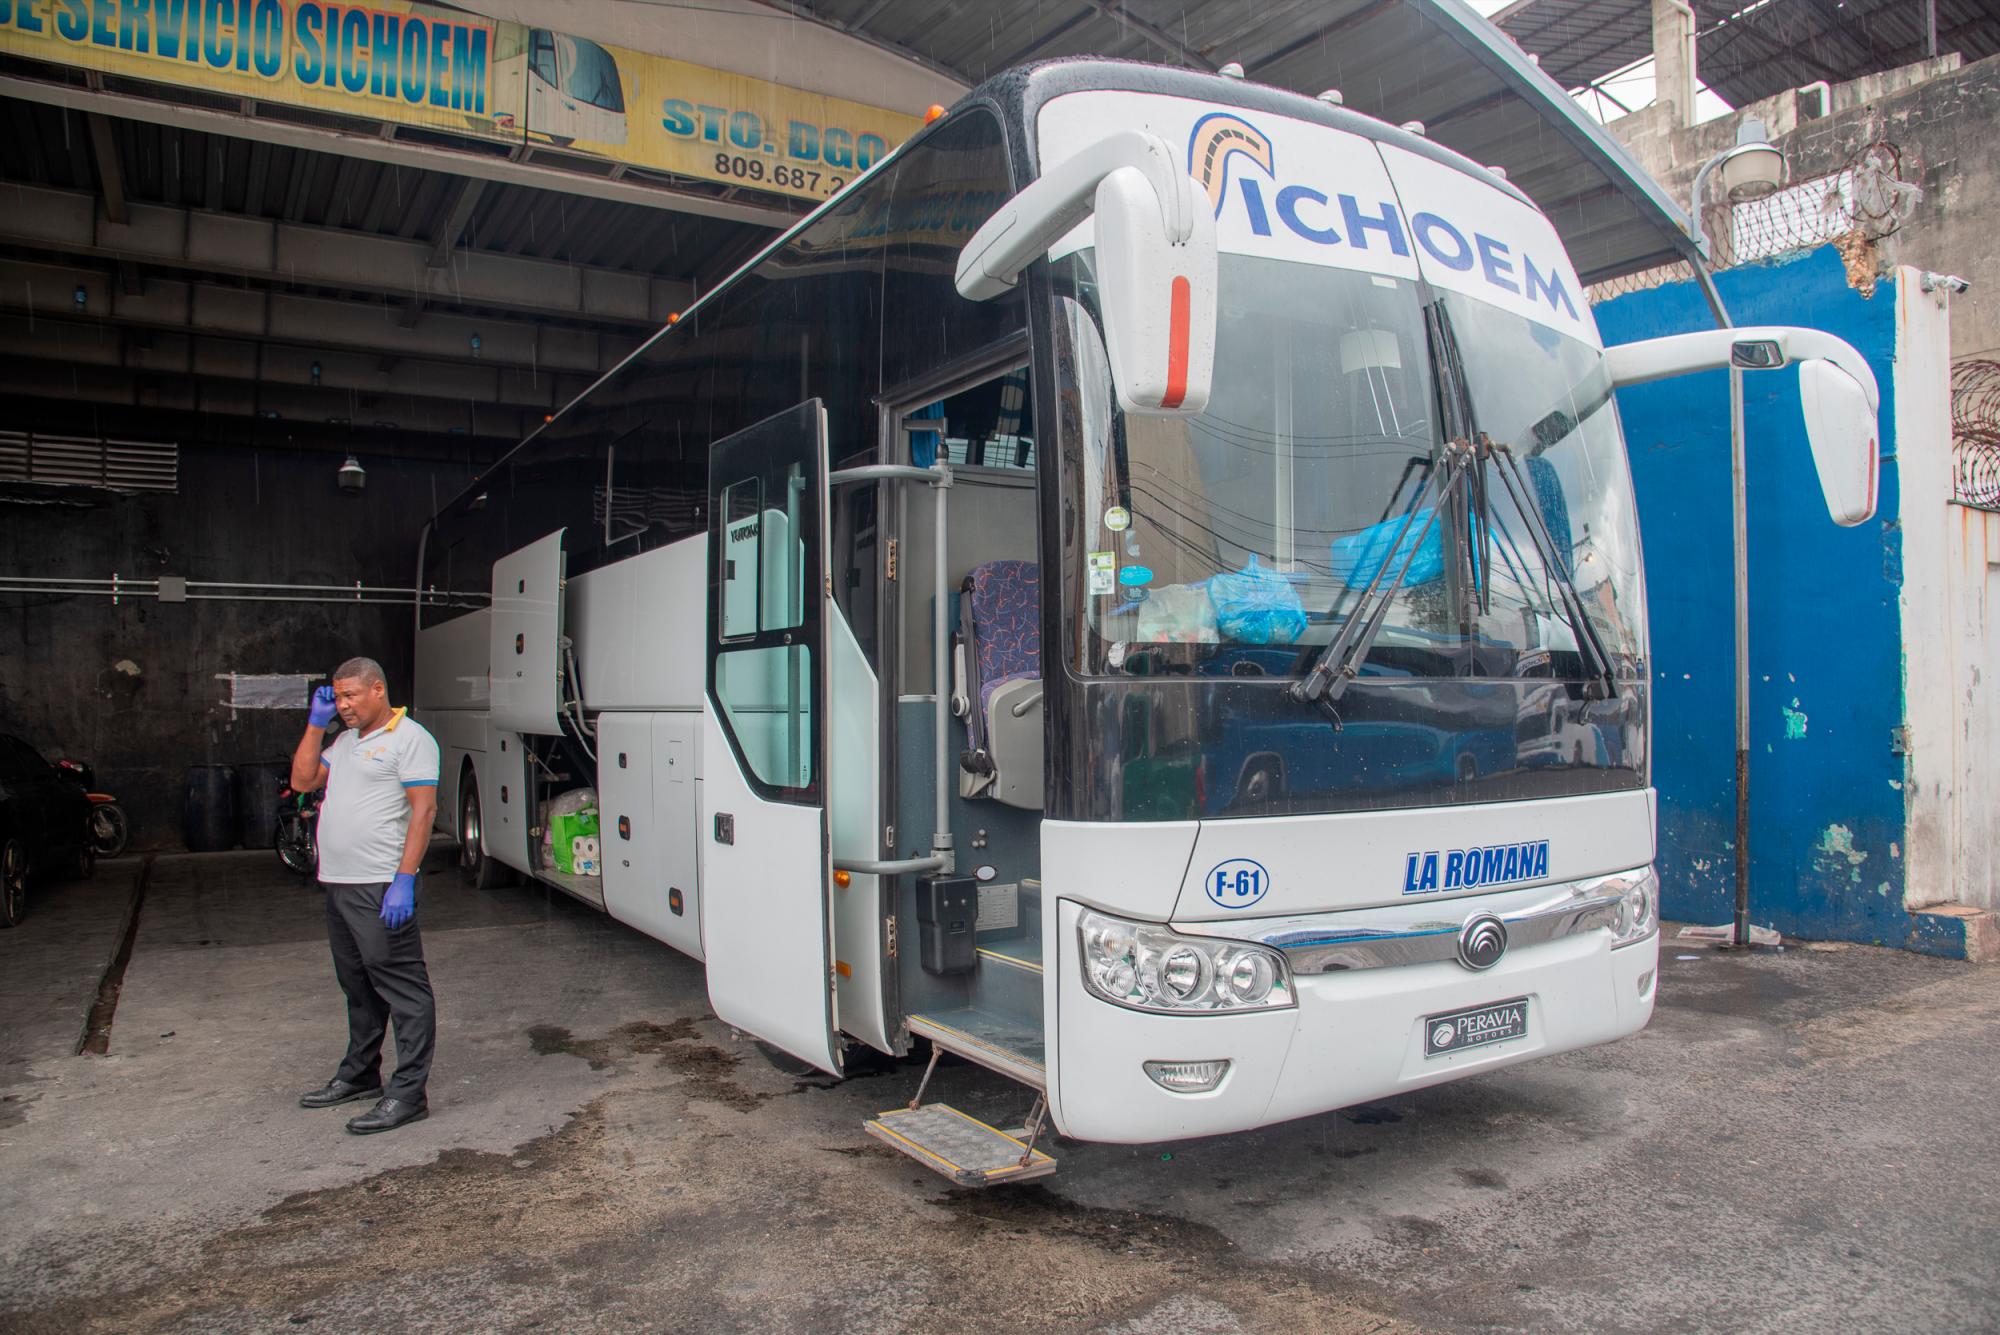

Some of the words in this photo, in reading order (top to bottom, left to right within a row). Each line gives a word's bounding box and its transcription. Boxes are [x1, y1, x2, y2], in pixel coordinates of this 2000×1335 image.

[56, 0, 284, 79] SERVICIO
[294, 2, 488, 116] SICHOEM
[662, 98, 776, 154] STO.
[1215, 869, 1260, 898] F-61
[1402, 852, 1440, 896] LA
[1442, 838, 1550, 890] ROMANA
[1457, 1008, 1522, 1035] PERAVIA
[1466, 1028, 1513, 1043] MOTORS
